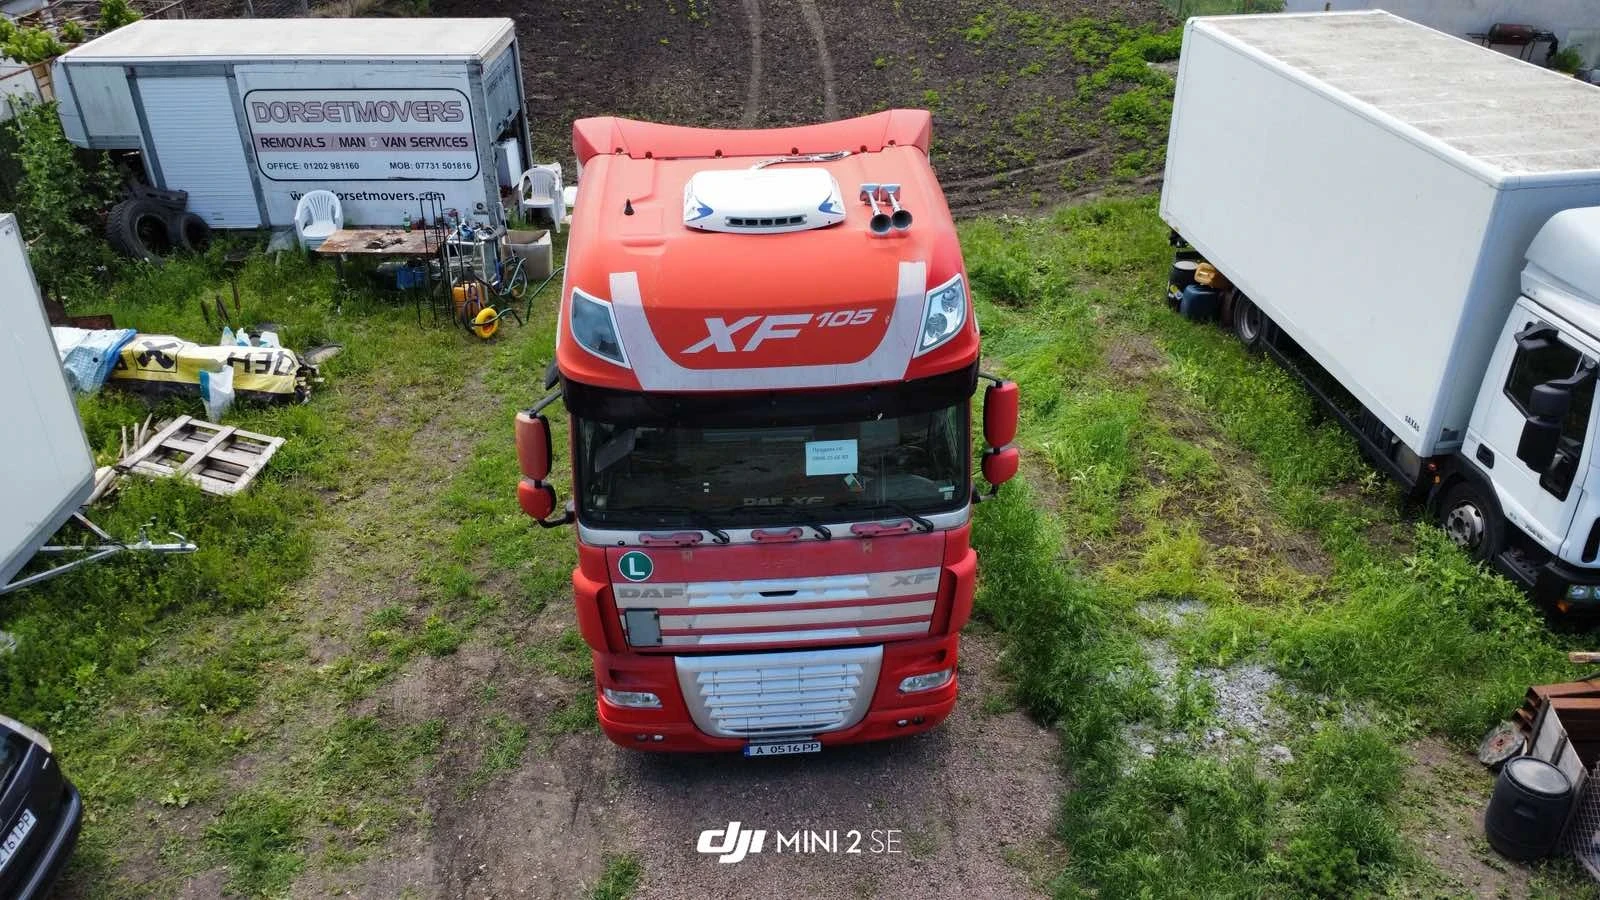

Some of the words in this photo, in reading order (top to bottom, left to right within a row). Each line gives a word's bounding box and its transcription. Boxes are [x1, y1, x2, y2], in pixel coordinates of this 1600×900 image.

[252, 101, 464, 123] DORSETMOVERS
[260, 137, 326, 148] REMOVALS
[339, 137, 366, 148] MAN
[381, 136, 407, 148] VAN
[410, 136, 469, 148] SERVICES
[303, 162, 329, 170] 01202
[415, 162, 440, 170] 07731
[442, 162, 472, 170] 501816
[680, 313, 814, 354] XF
[816, 308, 878, 328] 105
[629, 557, 645, 576] L
[889, 572, 937, 588] XF
